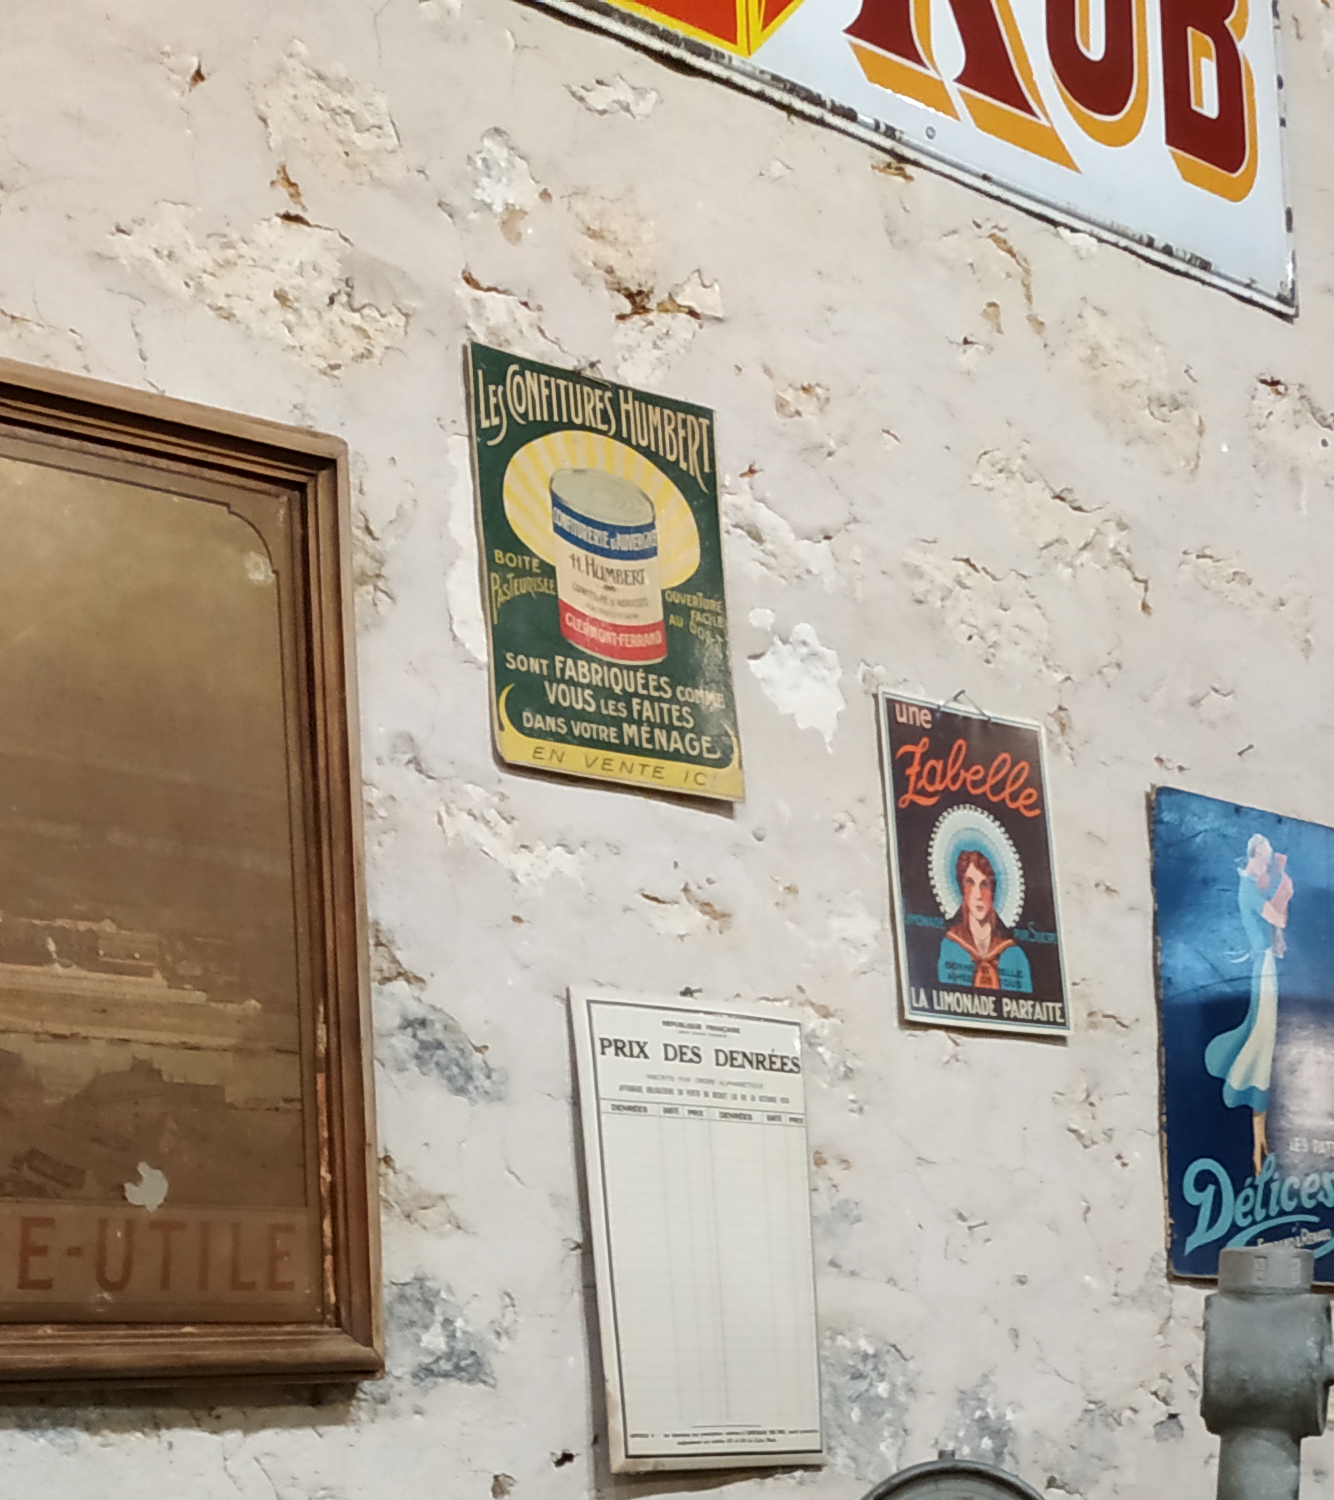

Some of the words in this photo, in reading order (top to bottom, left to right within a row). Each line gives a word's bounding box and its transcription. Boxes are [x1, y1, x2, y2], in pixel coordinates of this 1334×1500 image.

[476, 367, 509, 447] LES
[505, 363, 616, 438] CONFITURES
[617, 388, 712, 494] HUMBERT
[584, 554, 647, 586] HUMBERT
[665, 590, 723, 612] OUVERTURE
[564, 612, 662, 648] CLERMONT-FERRAND
[669, 614, 684, 628] AU
[505, 652, 549, 679] SONT
[553, 654, 673, 701] FABRIQUÉES
[544, 681, 597, 713] VOUS
[600, 697, 628, 719] LES
[631, 698, 695, 729] FAITES
[895, 701, 933, 730] une
[522, 709, 568, 736] DANS
[570, 718, 622, 744] VOTRE
[531, 745, 566, 765] EN
[583, 755, 667, 781] VENTE
[910, 986, 930, 1010] LA
[931, 989, 998, 1018] LIMONADE
[1001, 997, 1066, 1024] PARFAITE
[599, 1037, 651, 1060] PRIX
[662, 1042, 703, 1065] DES
